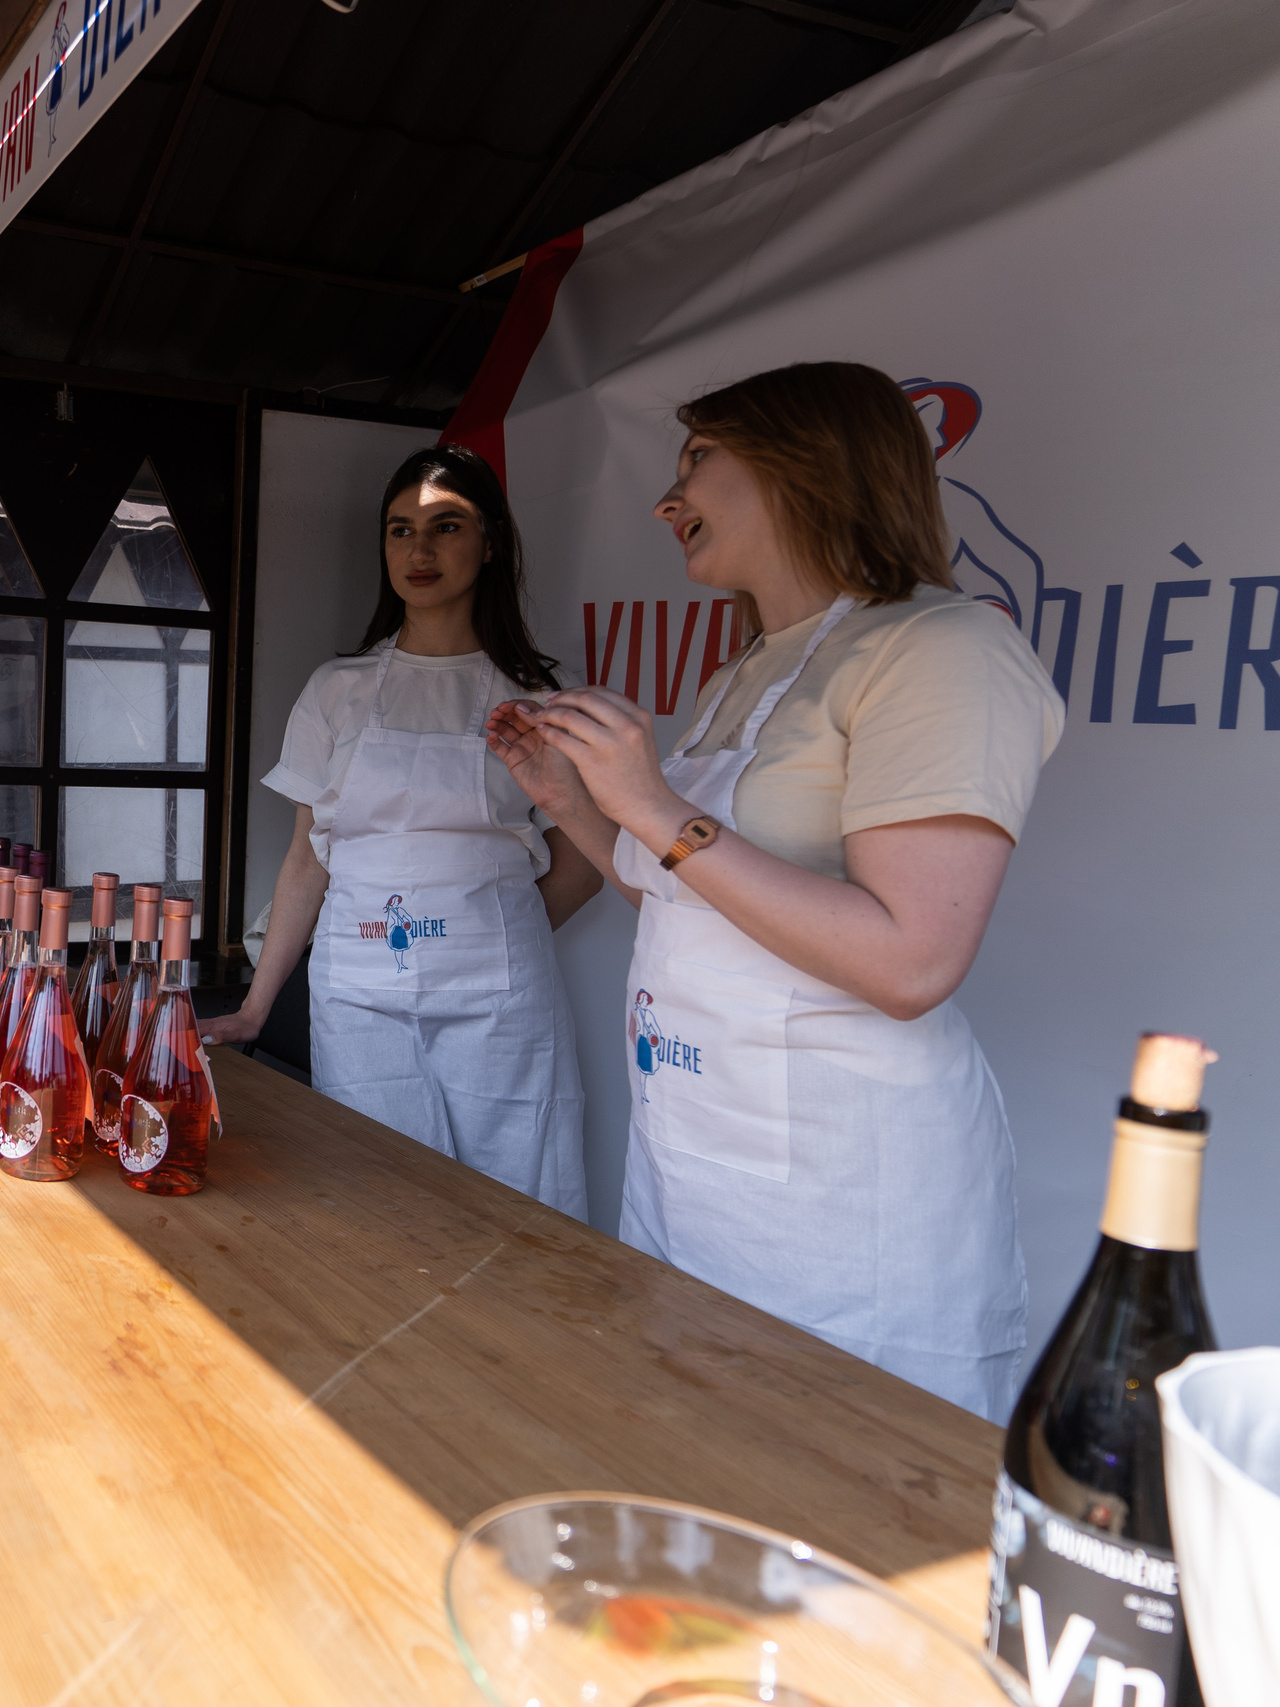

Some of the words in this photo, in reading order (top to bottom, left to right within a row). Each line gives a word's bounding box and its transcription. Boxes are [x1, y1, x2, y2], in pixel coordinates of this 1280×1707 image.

[358, 921, 388, 940] VIVAN
[411, 915, 447, 939] DIÈRE
[658, 1035, 703, 1075] DIÈRE
